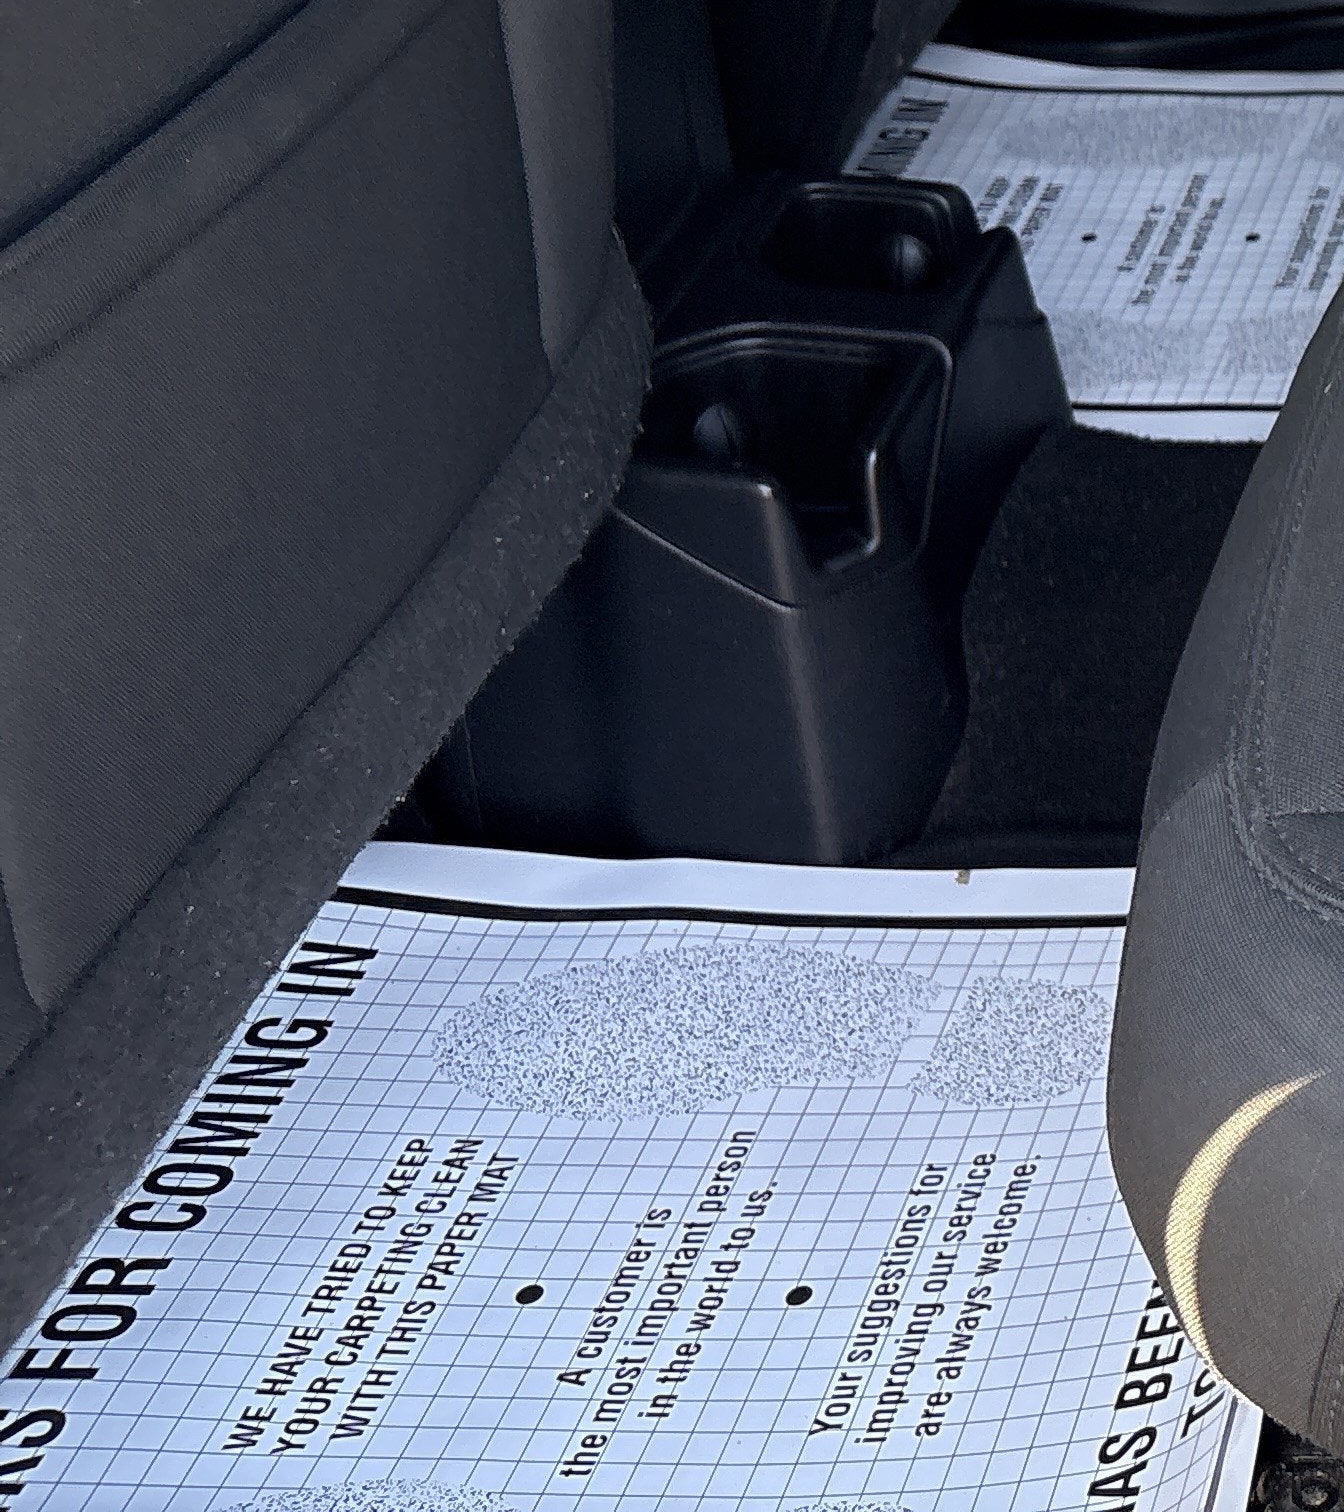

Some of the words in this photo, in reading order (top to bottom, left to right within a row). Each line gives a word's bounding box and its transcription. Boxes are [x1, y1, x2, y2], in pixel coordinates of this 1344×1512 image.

[8, 1258, 174, 1379] FOR
[114, 1016, 335, 1232] COMING
[277, 941, 379, 996] IN
[221, 1406, 277, 1450] WE
[255, 1326, 323, 1396] HAVE
[302, 1243, 372, 1317] TRIED
[353, 1206, 396, 1234] TO
[377, 1139, 434, 1196] KEEP
[270, 1376, 345, 1454] YOUR
[324, 1223, 434, 1365] CARPETING
[415, 1139, 483, 1213] CLEAN
[329, 1370, 399, 1438] WITH
[376, 1301, 436, 1359] THIS
[416, 1212, 488, 1290] PAPER
[467, 1152, 519, 1202] MAT
[687, 1260, 741, 1333] world
[720, 1227, 755, 1251] to
[741, 1182, 778, 1217] us.
[915, 1392, 952, 1437] are
[935, 1286, 992, 1380] always
[974, 1154, 1041, 1277] welcome.
[557, 1368, 592, 1386] A
[577, 1237, 656, 1358] customer
[635, 1208, 671, 1228] is
[560, 1434, 607, 1477] the
[593, 1357, 647, 1422] most
[624, 1222, 712, 1346] important
[698, 1131, 756, 1212] person
[638, 1394, 679, 1417] in
[656, 1343, 701, 1383] the
[809, 1372, 862, 1436] Your
[847, 1204, 931, 1362] suggestions
[910, 1163, 948, 1196] for
[854, 1302, 944, 1444] improving
[923, 1251, 957, 1292] our
[943, 1153, 996, 1244] service
[1087, 1426, 1157, 1512] AS
